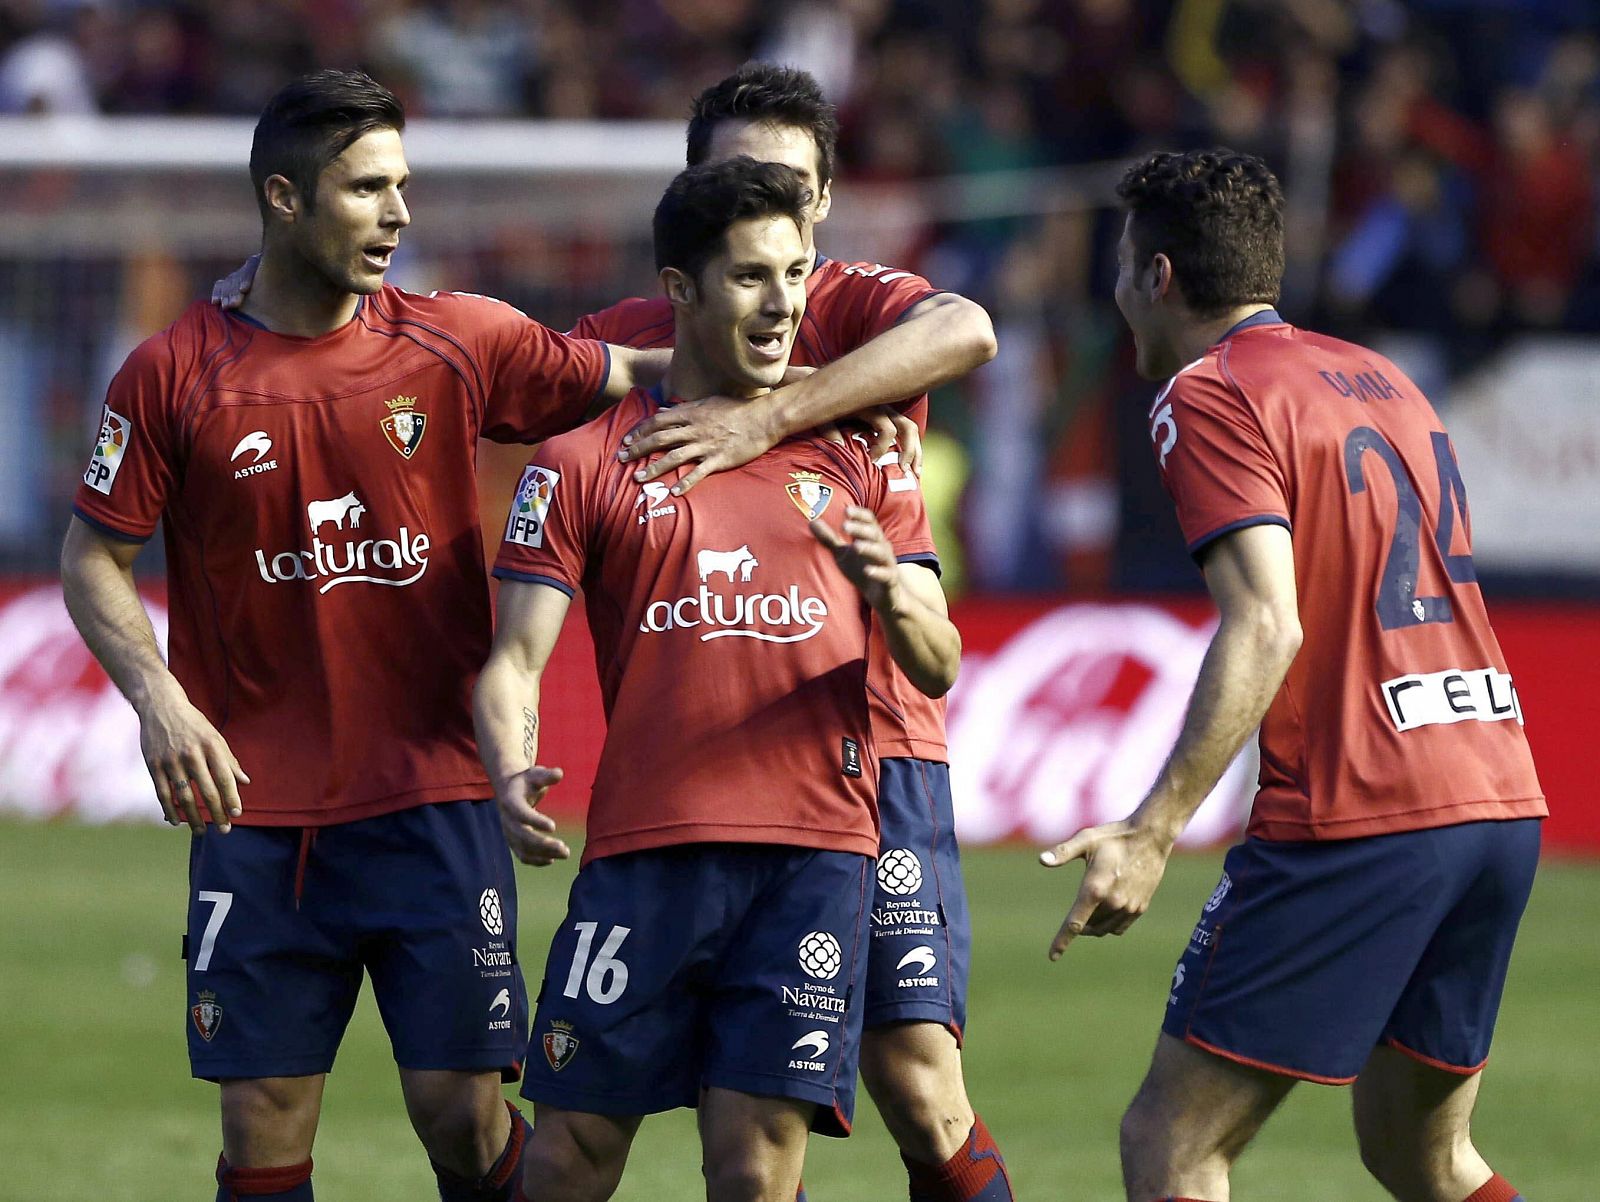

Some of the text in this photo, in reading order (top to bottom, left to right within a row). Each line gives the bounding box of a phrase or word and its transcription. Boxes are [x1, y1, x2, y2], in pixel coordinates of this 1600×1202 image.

[234, 459, 278, 480] ASTORE
[638, 504, 677, 526] ATORE
[1343, 426, 1478, 631] 24
[254, 526, 431, 586] lacturale
[639, 584, 829, 637] acturale
[885, 898, 922, 911] Reyno de
[194, 890, 233, 971] 7
[562, 920, 632, 1005] 16
[803, 981, 836, 995] Reyno de
[897, 976, 939, 988] ASTORE
[780, 984, 846, 1014] Navarra
[787, 1008, 808, 1019] Tierra
[808, 1011, 816, 1020] de
[787, 1060, 826, 1073] ASTORE
